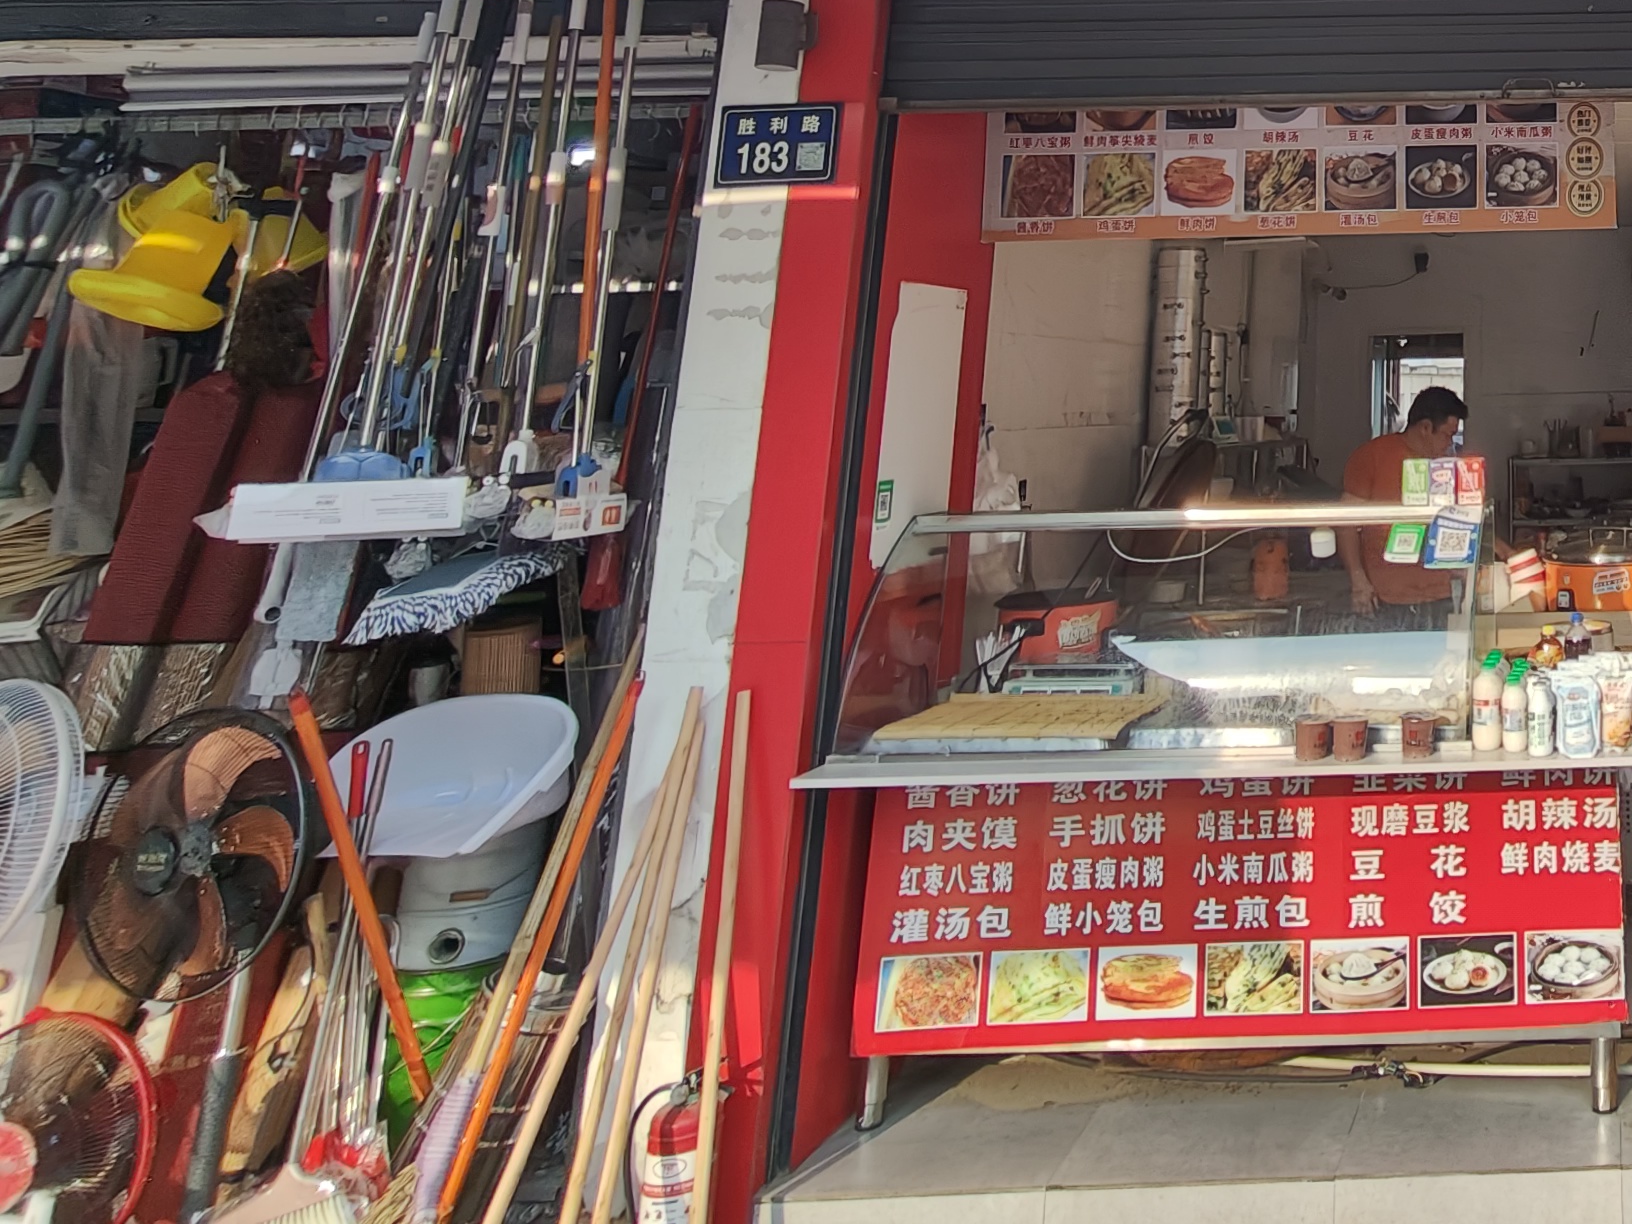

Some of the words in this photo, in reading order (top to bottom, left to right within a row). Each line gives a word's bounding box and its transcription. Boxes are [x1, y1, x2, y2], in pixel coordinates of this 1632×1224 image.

[736, 114, 821, 136] 胜利路
[1347, 129, 1375, 142] 豆花
[1410, 127, 1473, 140] 皮蛋瘦肉粥
[1490, 126, 1553, 139] 小米南瓜粥
[736, 140, 790, 175] 183
[1500, 209, 1538, 223] 小笼包
[901, 816, 1019, 853] 肉夹馍
[1048, 811, 1167, 848] 手抓饼
[1196, 806, 1315, 843] 鸡蛋土豆丝饼
[1350, 801, 1471, 837] 现磨豆浆
[1501, 796, 1618, 832] 胡辣汤
[897, 861, 1014, 897] 红枣八宝粥
[1046, 855, 1164, 892] 皮蛋瘦肉粥
[1192, 849, 1315, 886] 小米南瓜粥
[1349, 843, 1468, 881] 豆花
[1500, 839, 1621, 876] 鲜肉烧麦
[889, 904, 1012, 944] 灌汤包
[1043, 899, 1164, 937] 鲜小笼包
[1193, 894, 1310, 931] 生煎包
